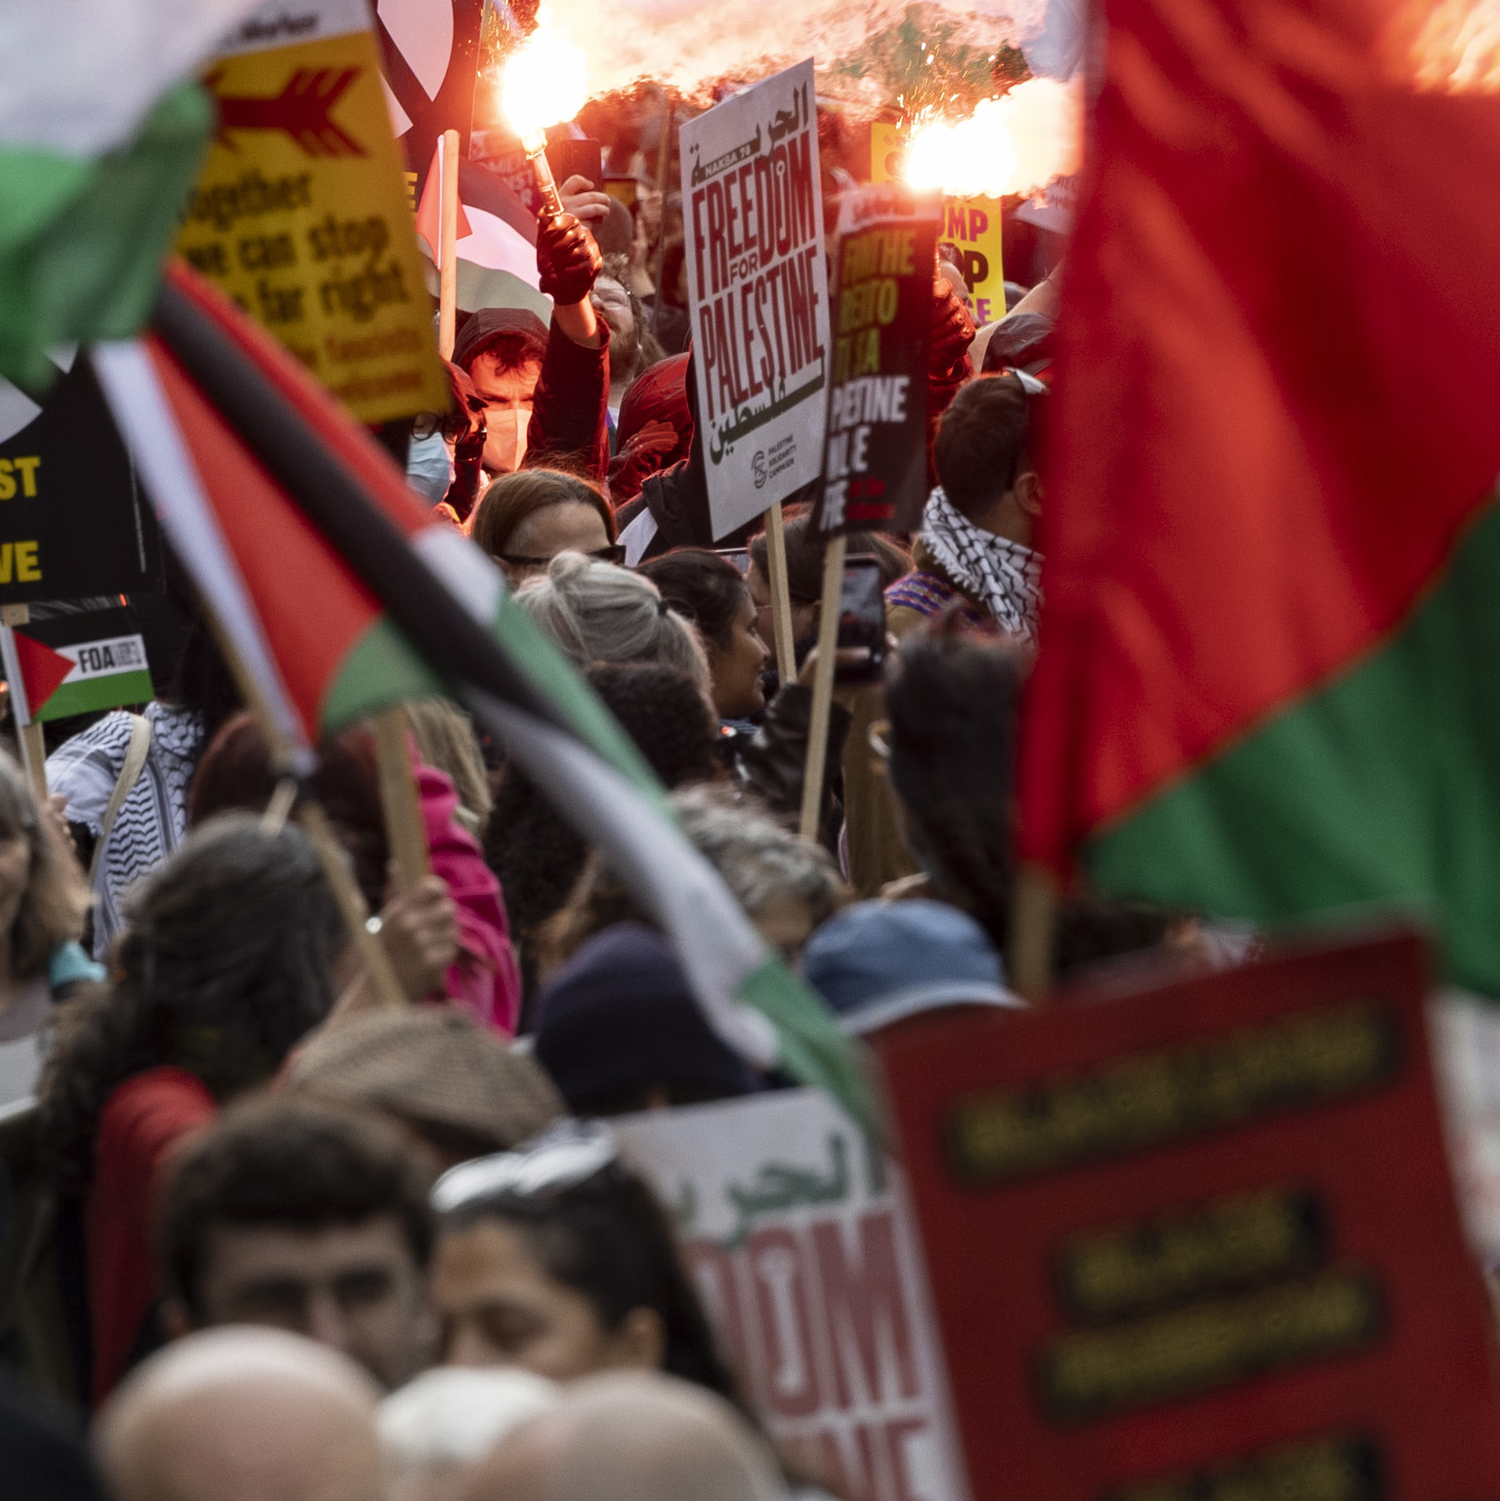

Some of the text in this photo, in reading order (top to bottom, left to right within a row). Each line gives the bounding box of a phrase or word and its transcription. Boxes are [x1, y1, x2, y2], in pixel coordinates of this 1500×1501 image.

[704, 152, 740, 178] NAKBA
[198, 171, 312, 232] ogether
[692, 130, 817, 305] FREEDOM
[238, 234, 297, 271] can
[306, 214, 388, 266] stop
[729, 251, 759, 287] FOR
[257, 263, 407, 323] far right
[698, 244, 825, 422] PALESTINE
[79, 645, 116, 673] FOA
